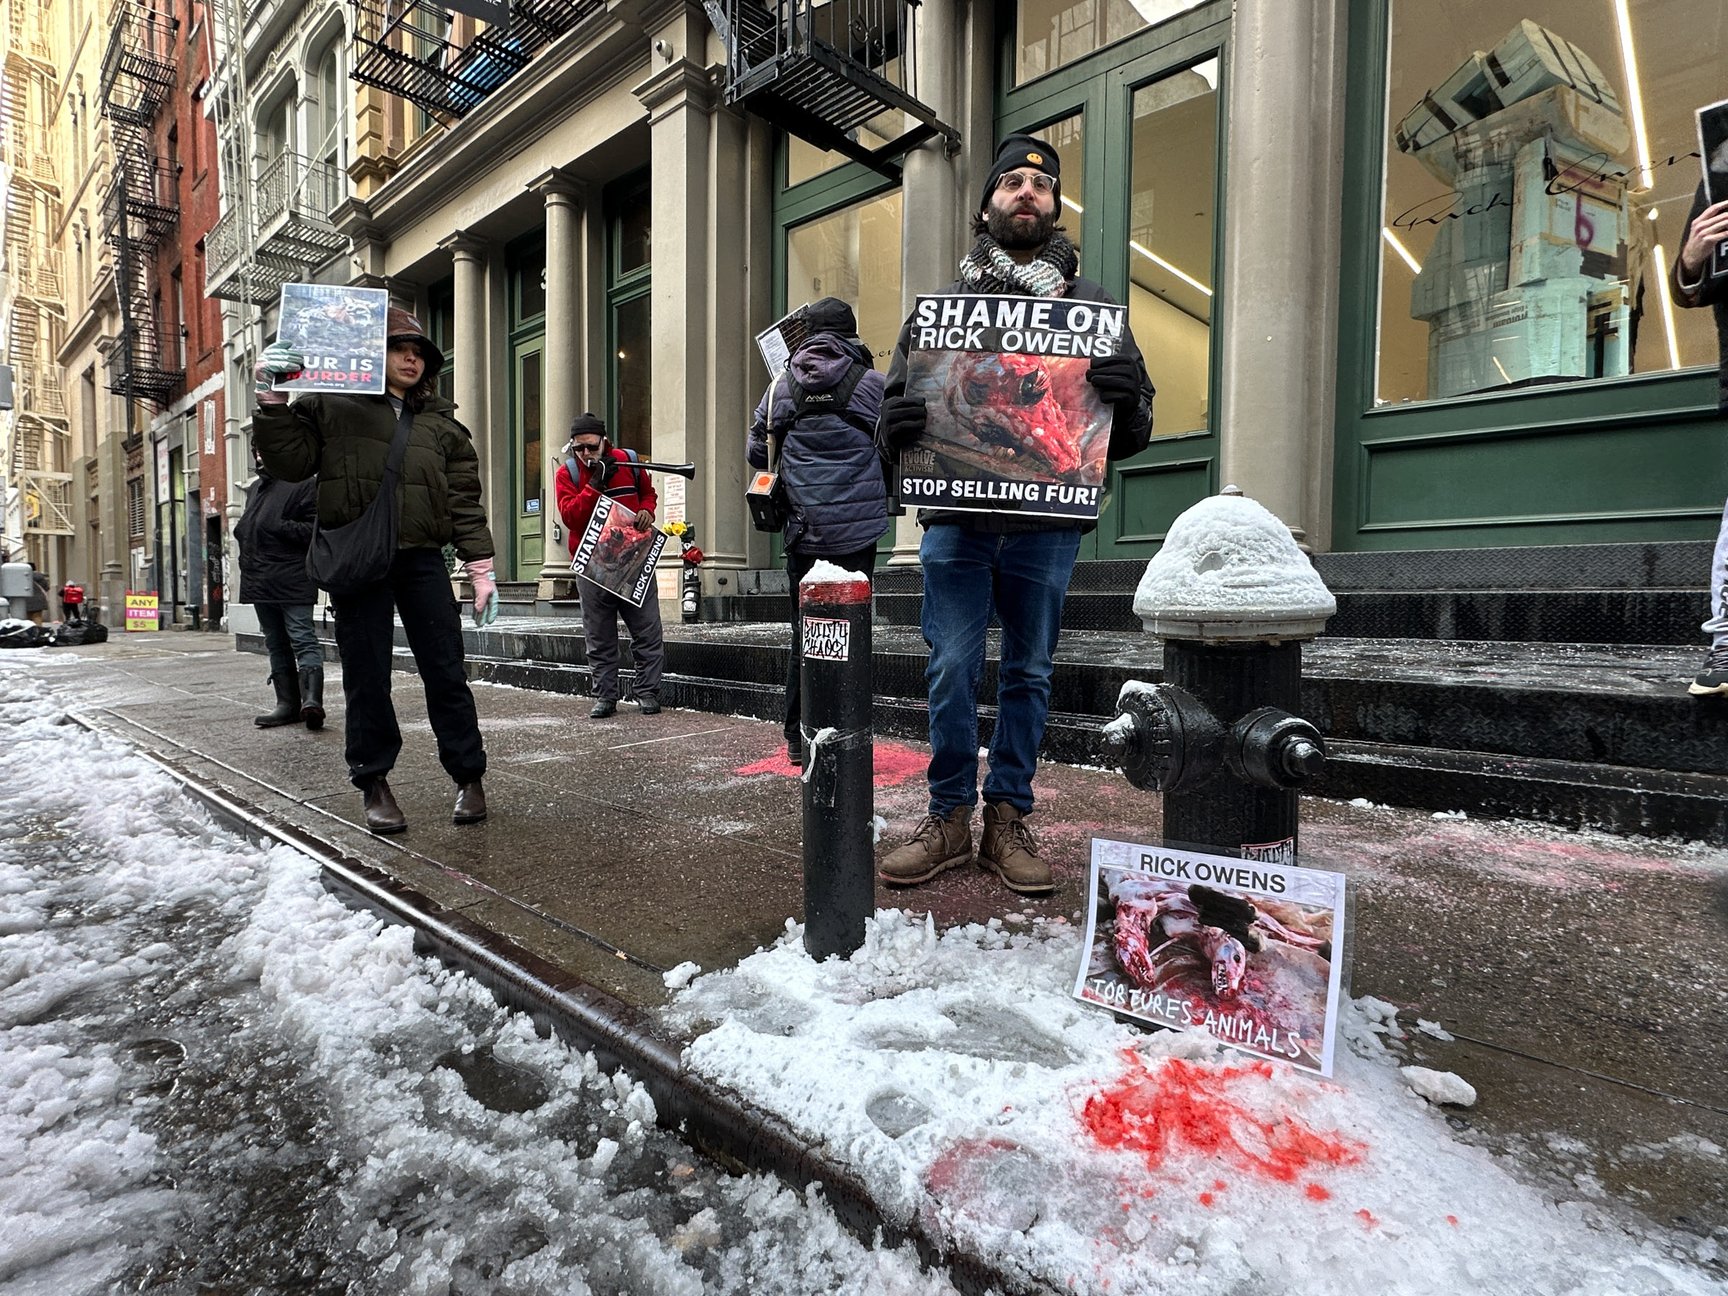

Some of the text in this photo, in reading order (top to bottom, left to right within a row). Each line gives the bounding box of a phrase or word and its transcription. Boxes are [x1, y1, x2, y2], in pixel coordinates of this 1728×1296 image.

[916, 299, 1124, 337] SHAME ON
[918, 327, 1114, 358] RICK OWENS
[304, 356, 374, 371] UR IS
[903, 449, 936, 466] EVOLVE
[904, 465, 934, 474] ACTIVISM
[902, 478, 1098, 506] STOP SELLING FUR!
[573, 497, 614, 574] SHAME ON
[632, 534, 665, 601] RICK OWENS
[1140, 853, 1286, 893] RICK OWENS
[1093, 978, 1301, 1059] TORTURES ANIMALS
